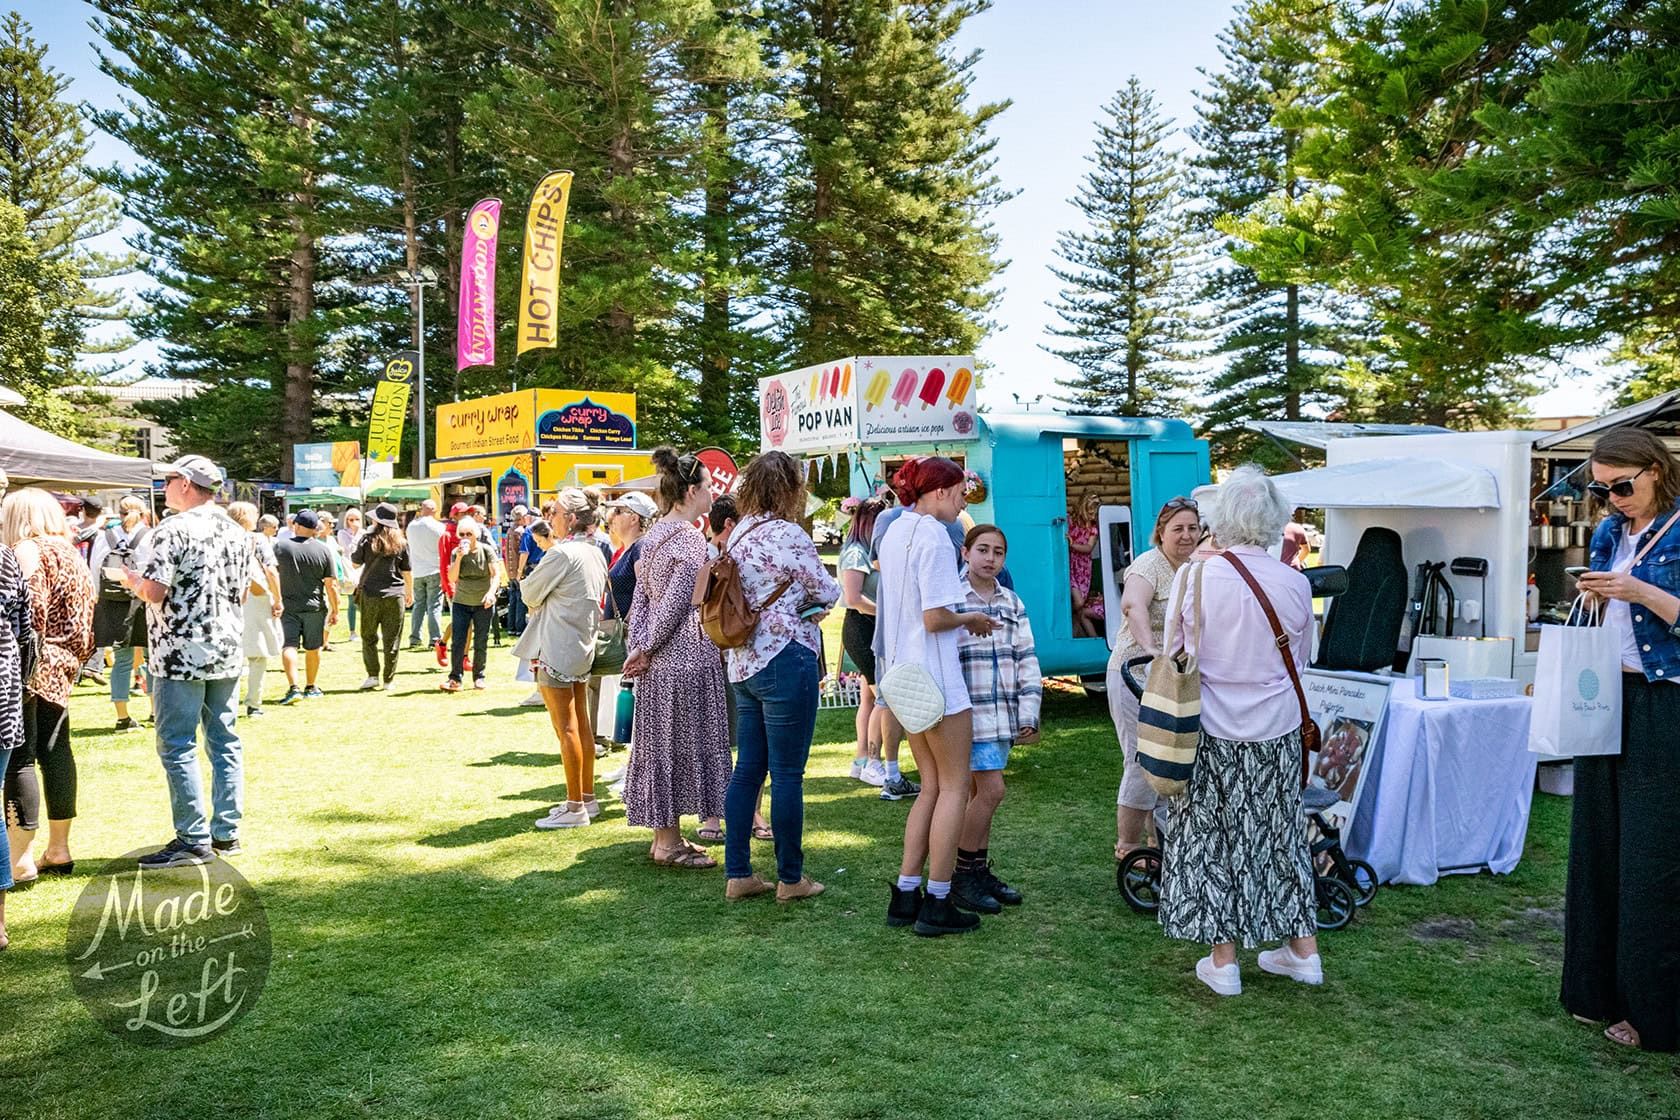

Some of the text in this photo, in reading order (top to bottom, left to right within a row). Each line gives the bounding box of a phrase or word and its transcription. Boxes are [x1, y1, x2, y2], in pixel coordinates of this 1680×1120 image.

[527, 184, 562, 342] HOT CHIPS
[471, 240, 488, 360] INDIAN FOOD
[371, 395, 389, 443] JUICE
[386, 384, 406, 454] STATION
[451, 404, 519, 435] curry wrap
[561, 414, 592, 428] wrap
[570, 407, 607, 422] curry
[798, 406, 852, 432] POP VAN
[451, 433, 519, 451] Gourmet Indian Street Food
[866, 423, 944, 436] Delicious artisan ice pops
[505, 486, 525, 499] curry
